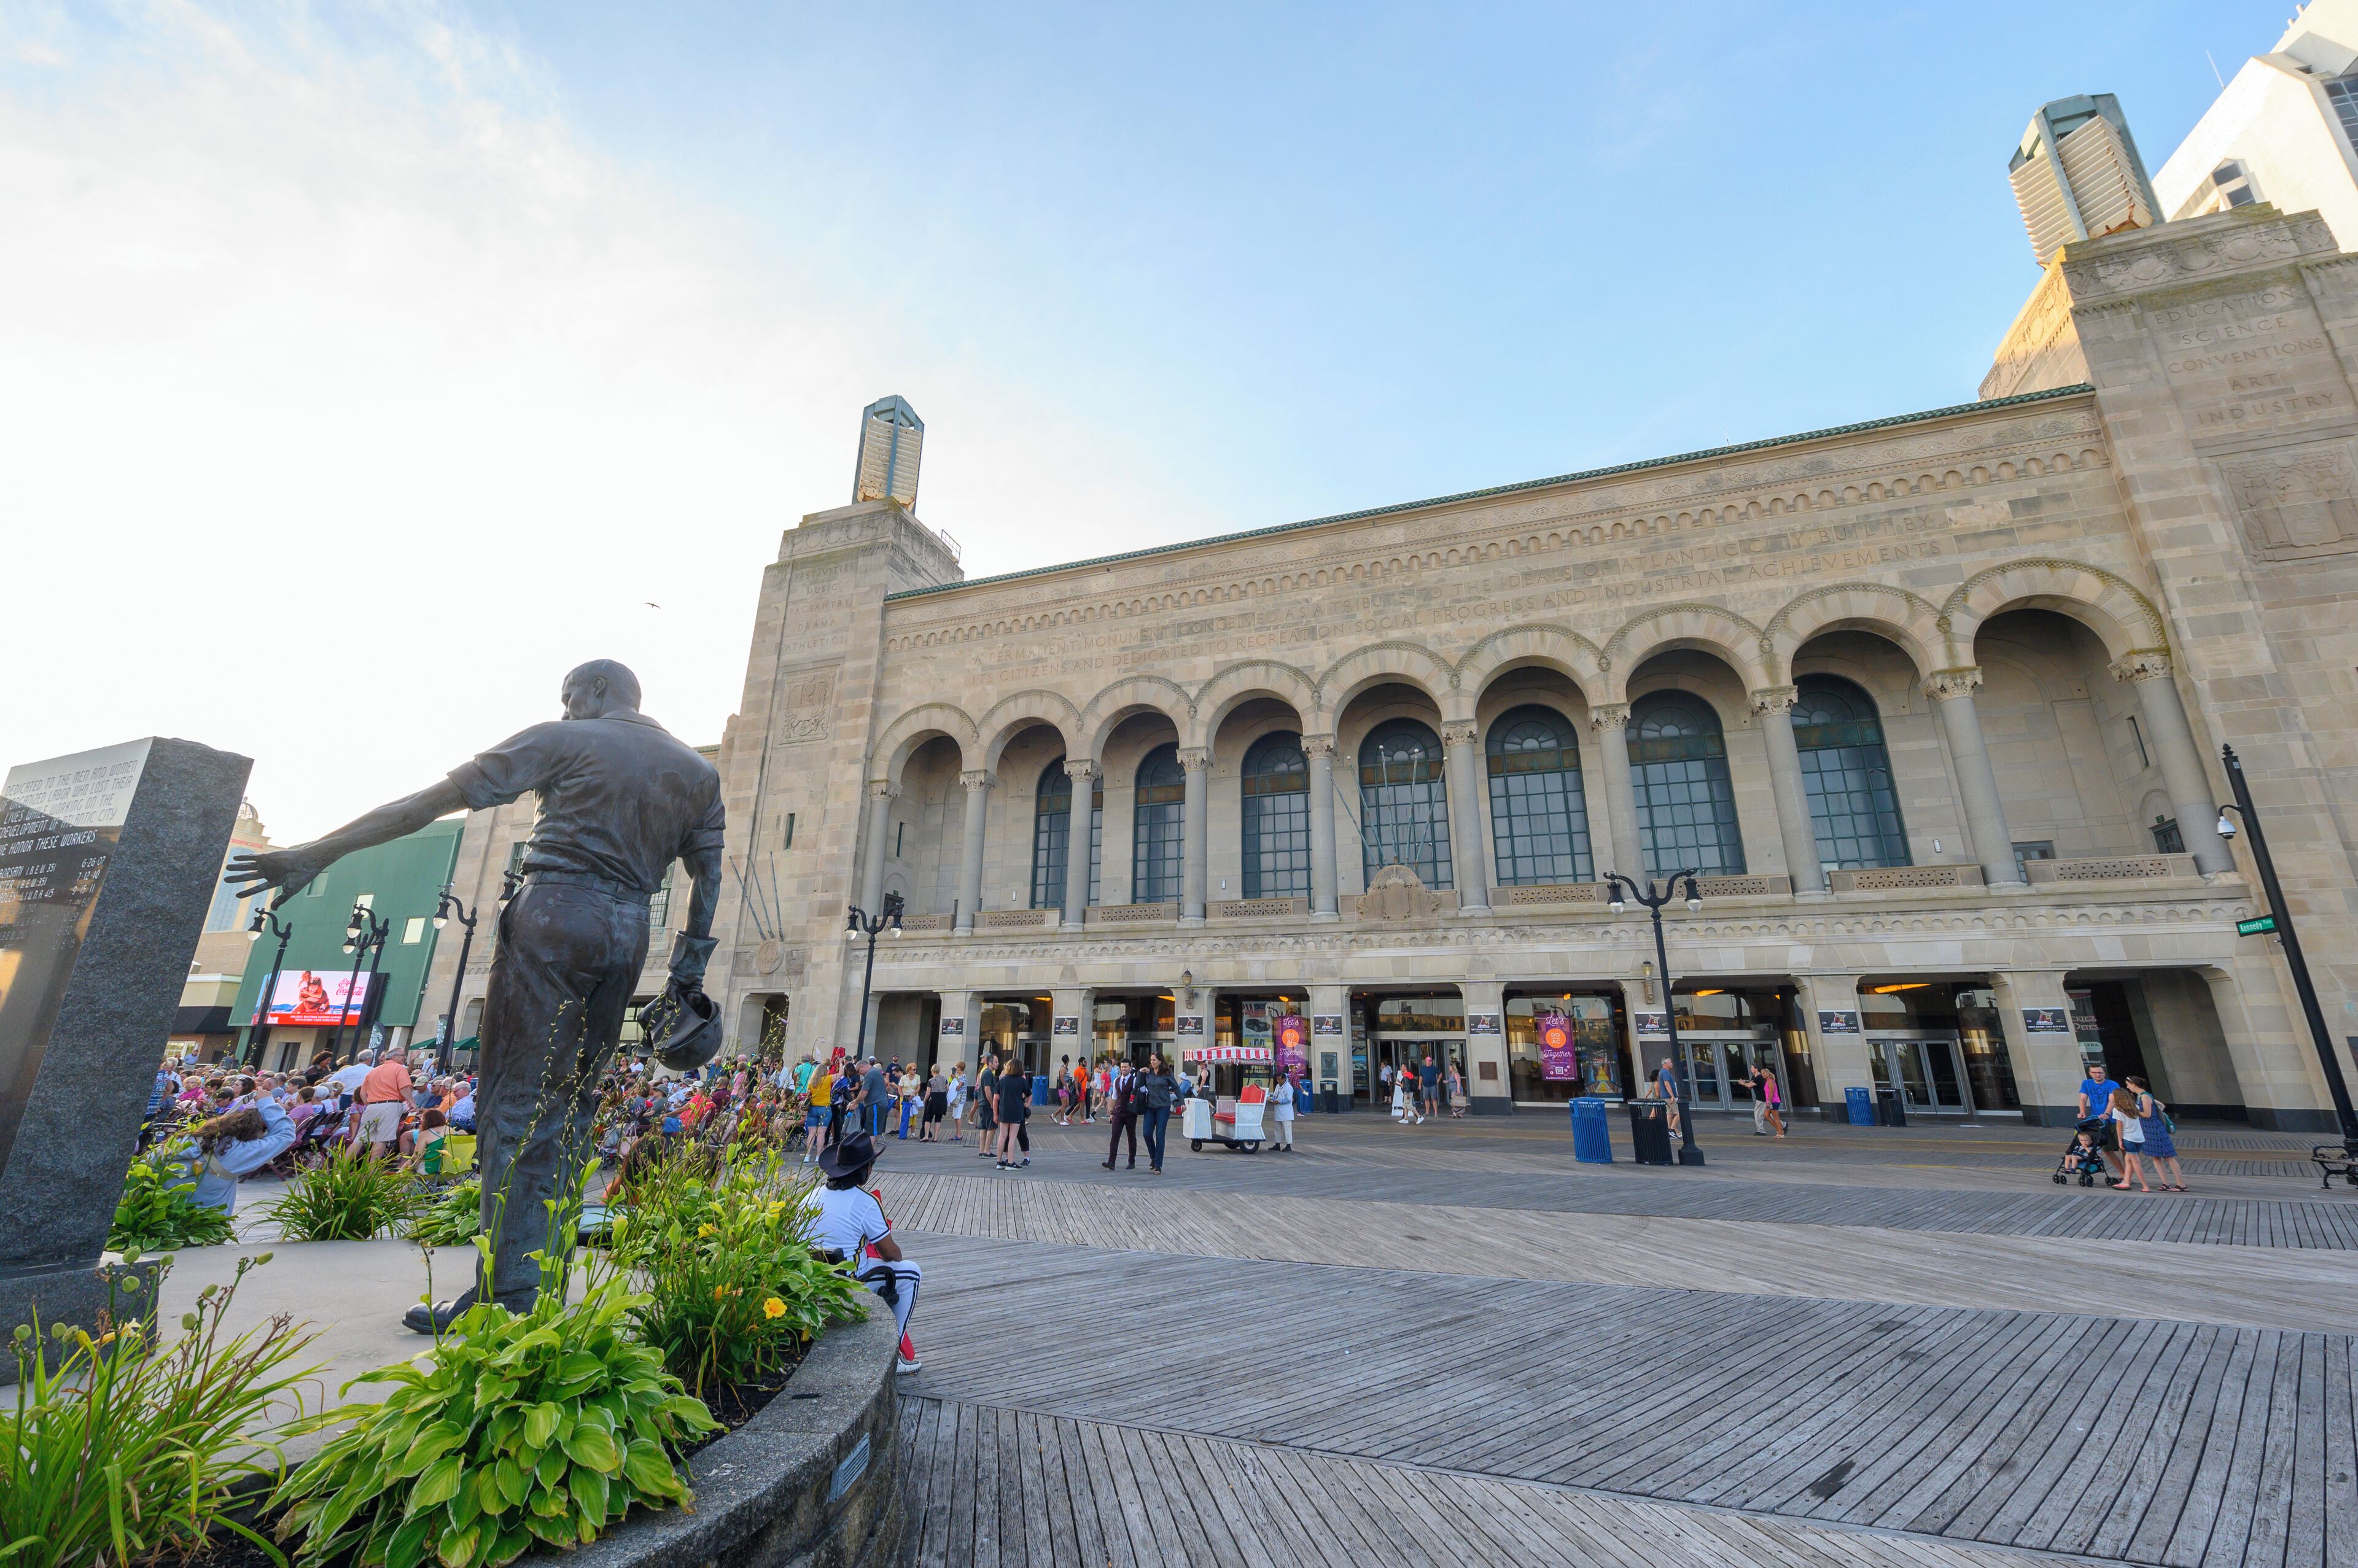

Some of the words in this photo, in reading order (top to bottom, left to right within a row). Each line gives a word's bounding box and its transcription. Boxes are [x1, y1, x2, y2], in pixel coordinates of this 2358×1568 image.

[2154, 289, 2295, 325] EDUCATION
[2182, 317, 2288, 345] SCIENCE
[2168, 338, 2324, 374] CONVENTIONS
[2231, 373, 2278, 391] ART
[2197, 392, 2334, 425] INDUSTRY
[795, 564, 855, 581] FESTIVITIES
[806, 583, 838, 595] MUSIC
[973, 654, 982, 664] A
[989, 640, 1078, 663] PERMANENT
[1084, 626, 1172, 649] MONUMENT
[1178, 611, 1278, 635] CONCEIVED
[1284, 607, 1306, 621] AS
[1313, 605, 1324, 616] A
[1331, 591, 1407, 613] TRIBUTE
[1416, 586, 1442, 602] TO
[1452, 579, 1491, 596] THE
[1500, 566, 1573, 588] IDEALS
[1582, 561, 1609, 577] OF
[1621, 543, 1739, 572] ATLANTIC
[1749, 533, 1804, 553] CITY
[1819, 519, 1893, 543] BUILT
[1903, 514, 1930, 531] BY
[790, 598, 850, 615] PAGEANTRY
[972, 673, 994, 685] ITS
[999, 662, 1067, 681] CITIZENS
[1073, 657, 1104, 672] AND
[1112, 644, 1200, 667] DEDICATED
[1205, 640, 1228, 654] TO
[1236, 623, 1345, 650] RECREATION
[1355, 613, 1423, 633] SOCIAL
[1433, 597, 1535, 623] PROGRESS
[1543, 590, 1587, 608] AND
[1597, 571, 1735, 601] INDUSTRIAL
[1748, 541, 1942, 580] ACHIEVEMENTS
[797, 618, 836, 632] DRAMA
[785, 635, 844, 652] ATHLETICS
[5, 779, 43, 797] DEDICATED
[45, 777, 55, 789] TO
[58, 773, 72, 786] THE
[72, 770, 90, 784] MEN
[91, 766, 107, 780] AND
[109, 760, 138, 776] WOMEN
[0, 800, 9, 812] OF
[10, 791, 47, 810] ORGANIZED
[47, 787, 71, 802] LABOR
[72, 784, 89, 798] WHO
[90, 780, 110, 794] LOST
[111, 775, 134, 791] THEIR
[4, 810, 25, 825] LIVES
[26, 805, 49, 820] WHILE
[49, 799, 83, 815] WORKING
[85, 796, 98, 809] ON
[99, 793, 115, 807] THE
[49, 817, 61, 830] OF
[61, 811, 97, 828] ATLANTIC
[98, 807, 119, 822] CITY
[9, 839, 34, 855] HONOR
[35, 835, 60, 851] THESE
[60, 829, 98, 847] WORKERS
[47, 863, 57, 872] 351
[2239, 922, 2263, 932] Kennedy
[336, 987, 364, 996] Cocaola
[1283, 1017, 1299, 1027] Let's
[1546, 1015, 1565, 1026] Let's
[1280, 1048, 1304, 1057] Together
[1544, 1049, 1572, 1060] Together
